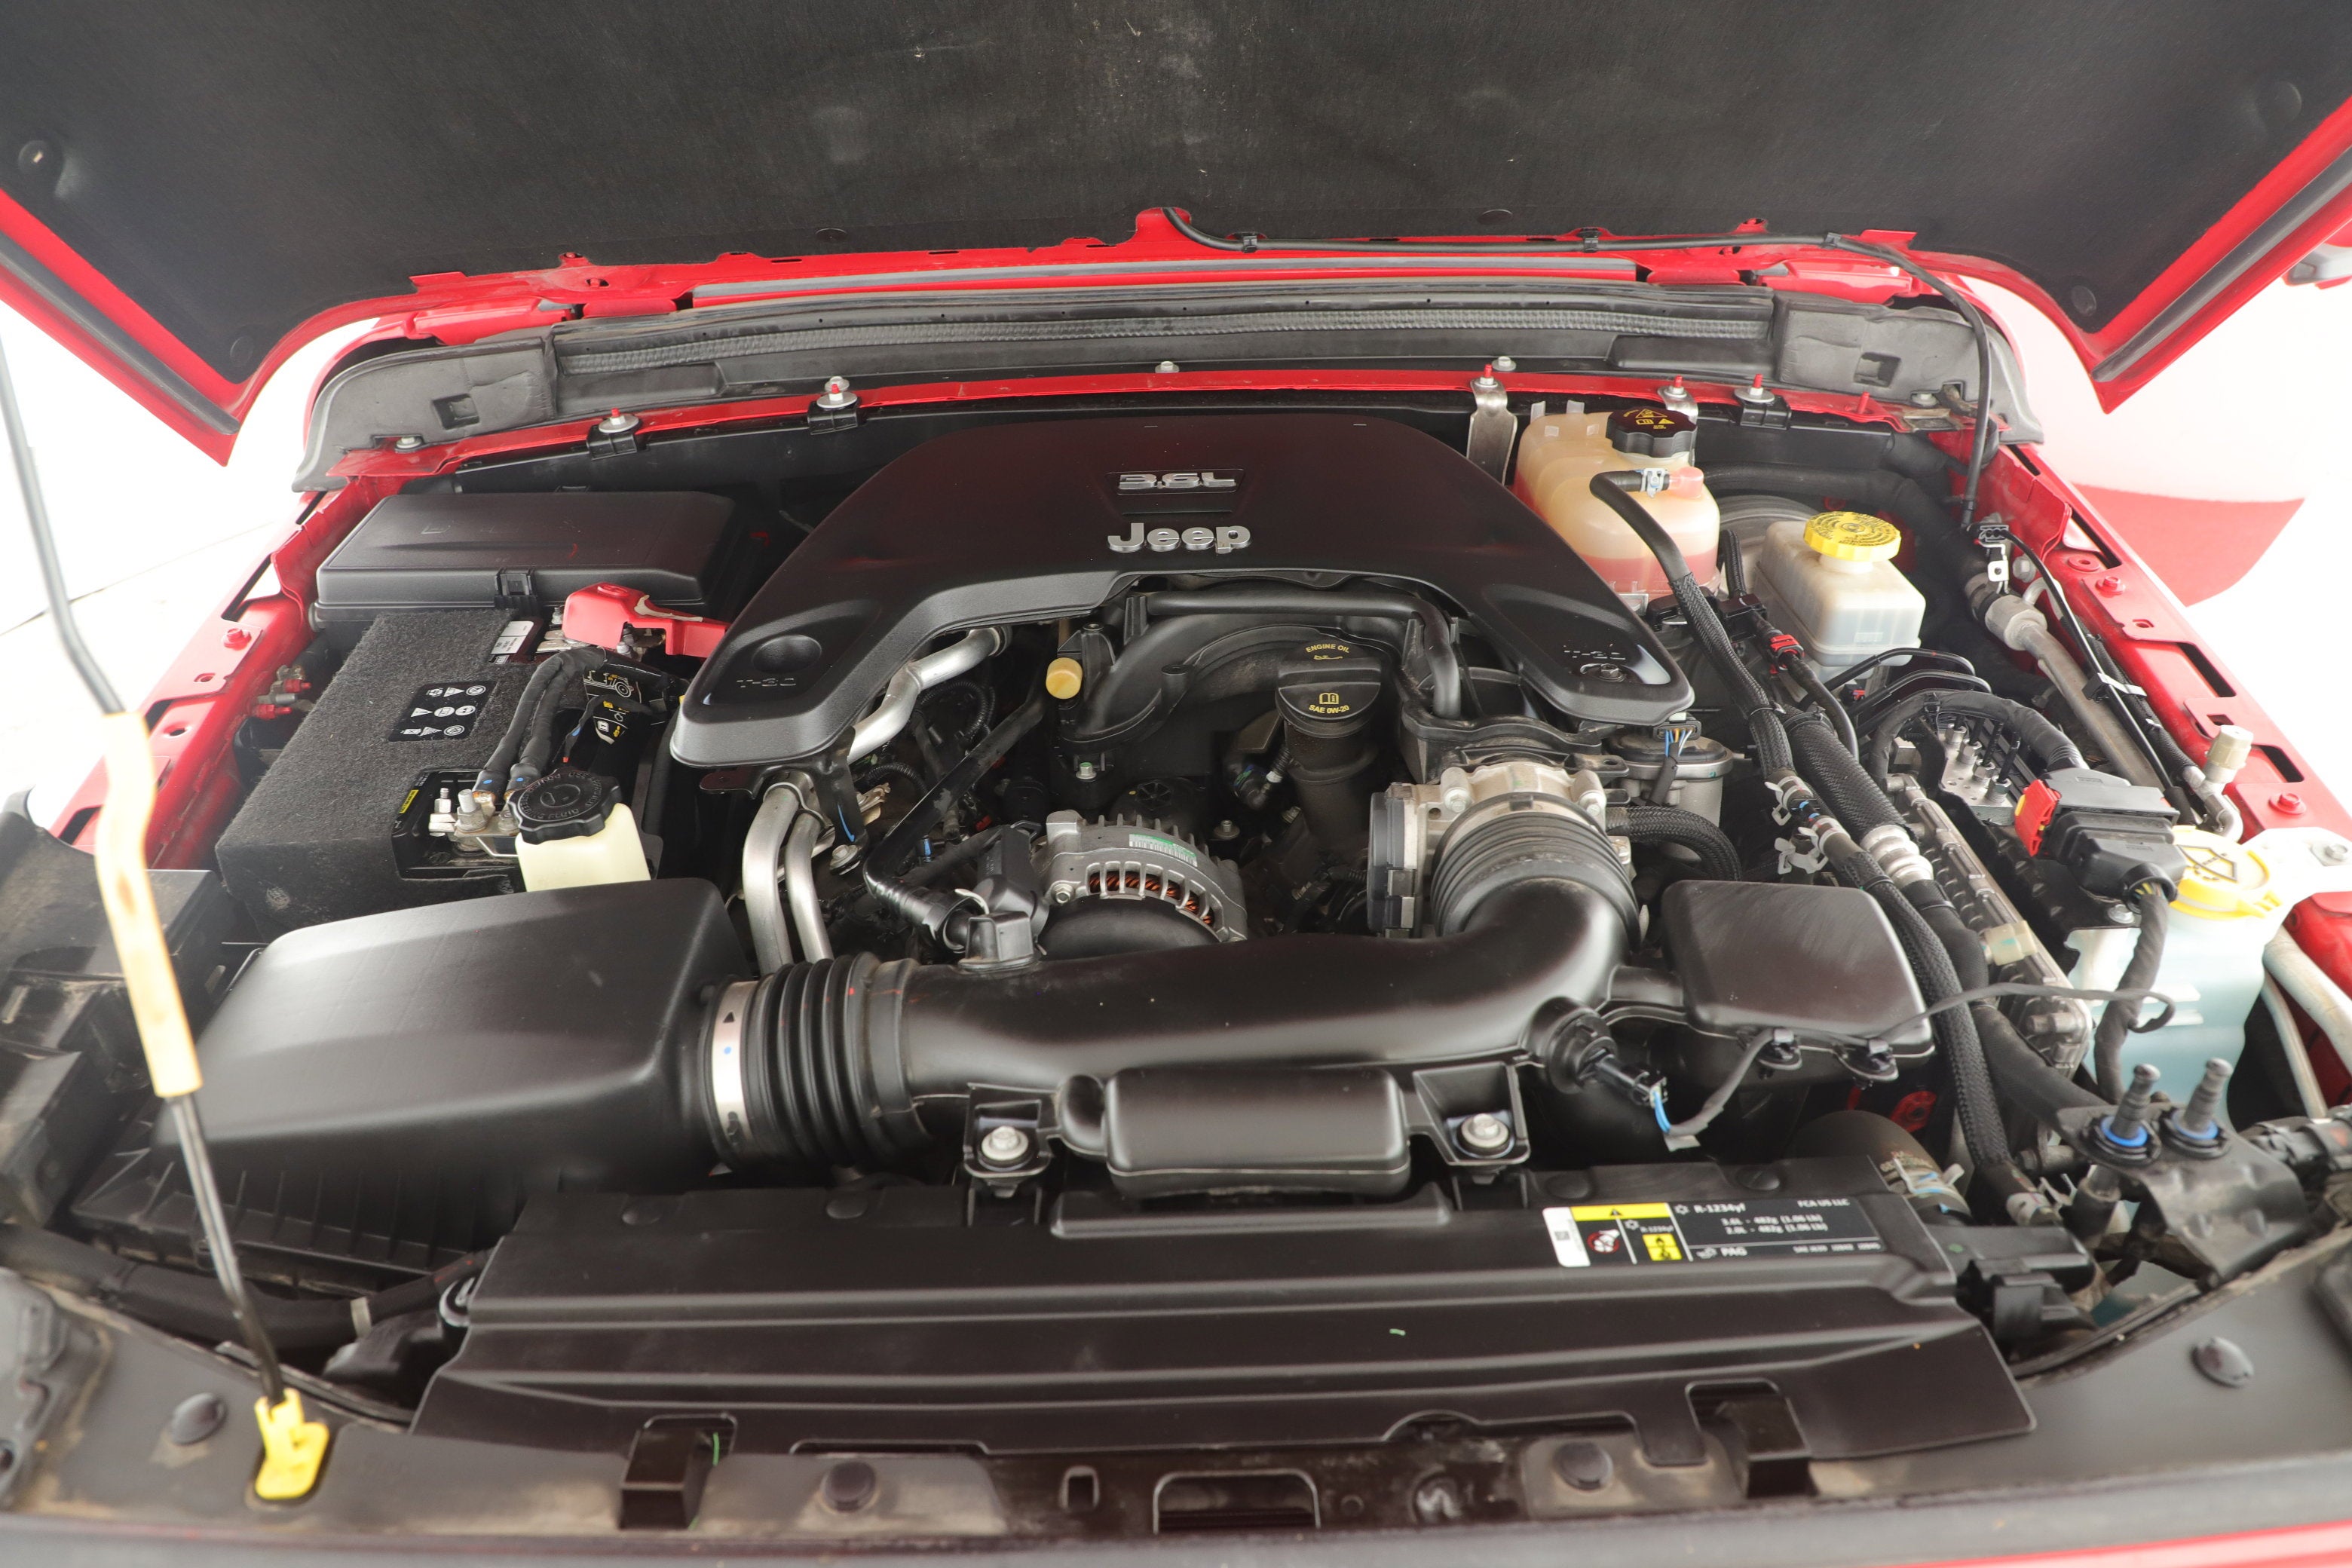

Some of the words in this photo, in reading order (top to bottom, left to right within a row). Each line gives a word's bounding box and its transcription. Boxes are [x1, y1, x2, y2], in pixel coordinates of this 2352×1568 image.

[1118, 472, 1237, 490] 3.6L
[1107, 522, 1251, 554] Jeep
[1306, 644, 1337, 654] ENGINE
[1337, 645, 1350, 654] OIL
[1309, 704, 1326, 714] SAE
[1326, 705, 1350, 714] 0W-20
[548, 807, 580, 819] FLUID
[1693, 1202, 1746, 1214] R-1234yf
